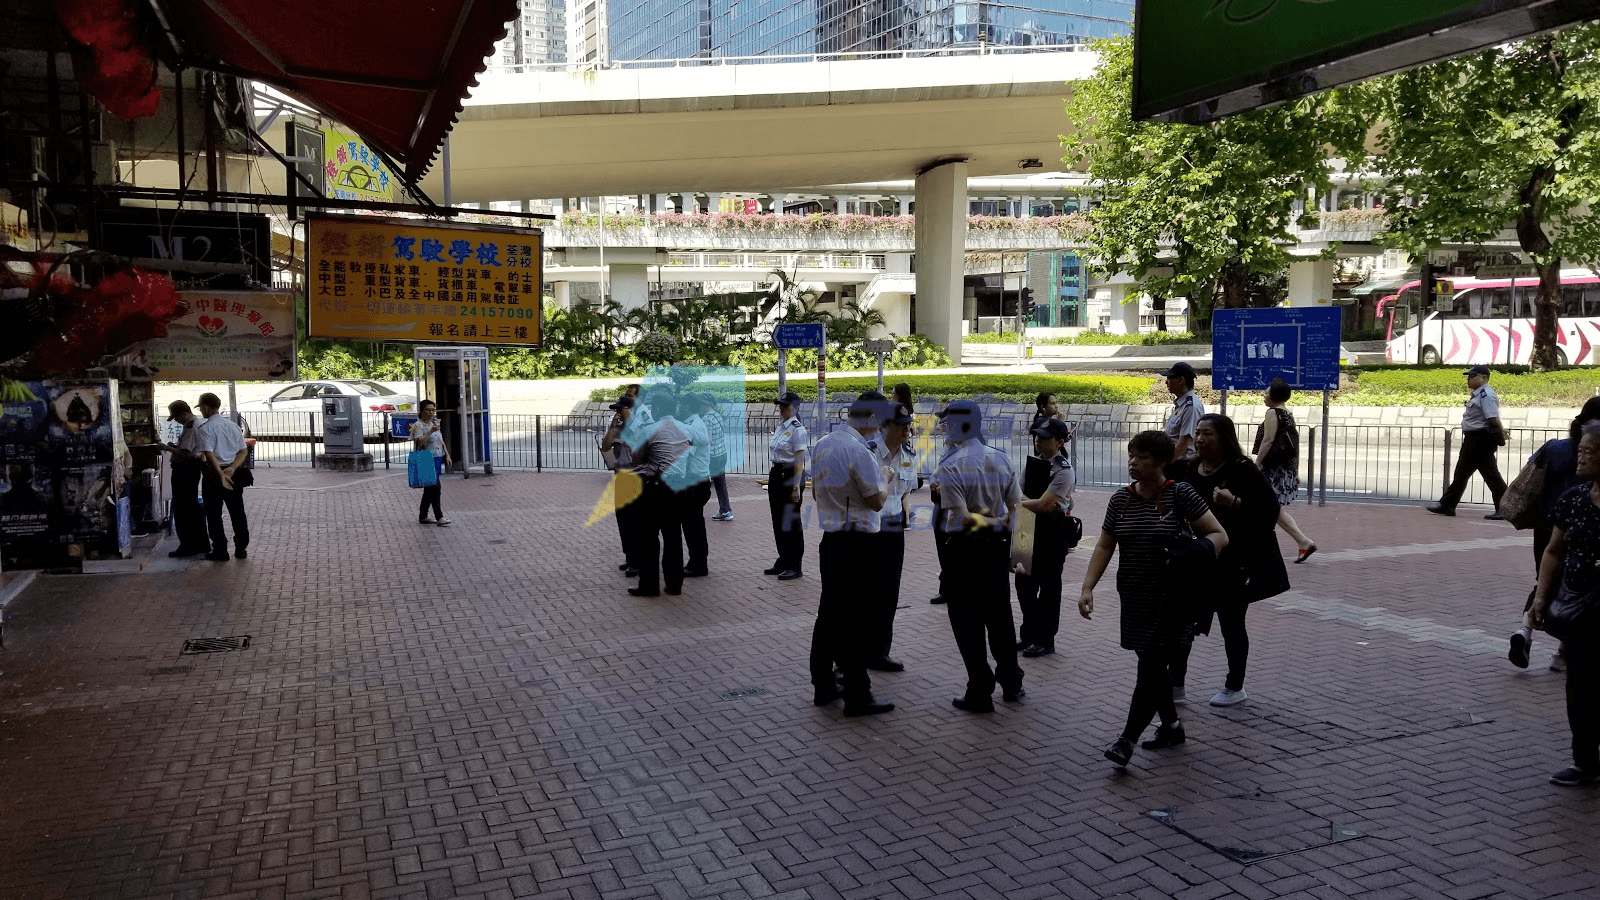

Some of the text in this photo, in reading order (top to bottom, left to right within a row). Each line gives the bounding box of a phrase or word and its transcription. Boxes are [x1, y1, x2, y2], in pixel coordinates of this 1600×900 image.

[147, 235, 213, 261] M2
[506, 243, 533, 257] 荃灣
[506, 256, 533, 269] 分校
[460, 305, 534, 320] 24157090
[428, 322, 529, 340] 報名請上三樓
